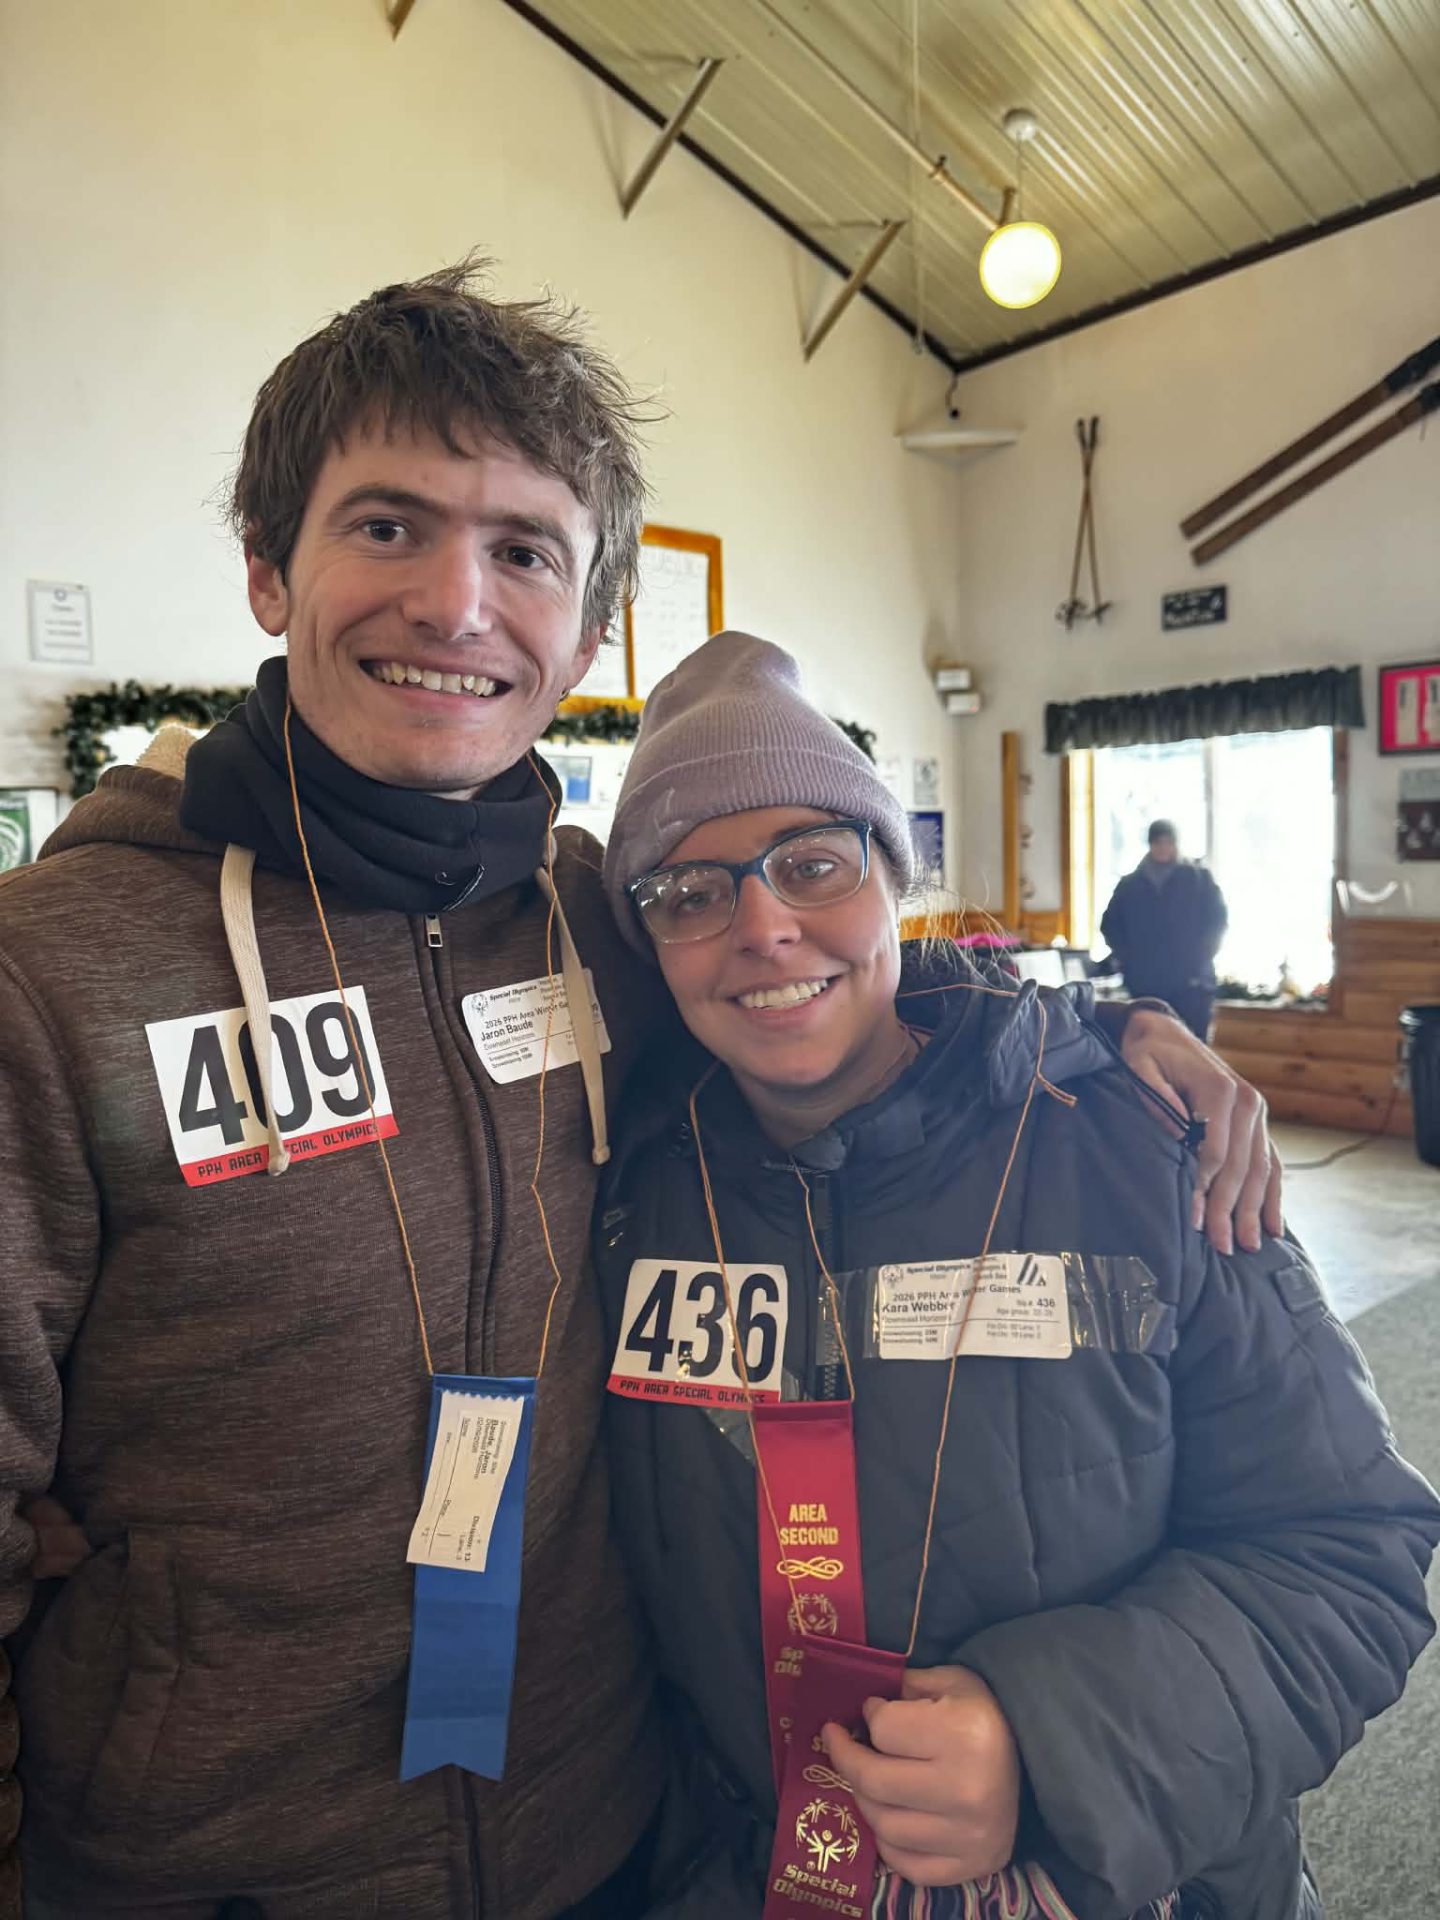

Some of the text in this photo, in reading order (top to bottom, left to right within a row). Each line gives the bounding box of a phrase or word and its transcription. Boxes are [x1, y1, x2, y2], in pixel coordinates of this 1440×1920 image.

[503, 1013, 518, 1024] PPH
[519, 1009, 535, 1019] Area
[481, 1027, 506, 1042] Jaron
[507, 1020, 534, 1034] Baude
[179, 1001, 376, 1146] 409
[198, 1161, 223, 1177] PPH
[228, 1153, 263, 1171] AREA
[893, 1292, 915, 1302] 2026
[917, 1291, 937, 1301] PPH
[989, 1284, 1021, 1295] Games
[1036, 1298, 1056, 1307] 436
[882, 1302, 909, 1313] Kara
[624, 1269, 779, 1382] 436
[619, 1380, 640, 1393] PPH
[643, 1383, 669, 1395] AREA
[673, 1386, 713, 1400] SPECIAL
[480, 1448, 490, 1474] Jaron
[789, 1504, 827, 1522] AREA
[779, 1527, 839, 1545] SECOND
[783, 1863, 858, 1898] Special
[772, 1877, 864, 1918] Olympics
